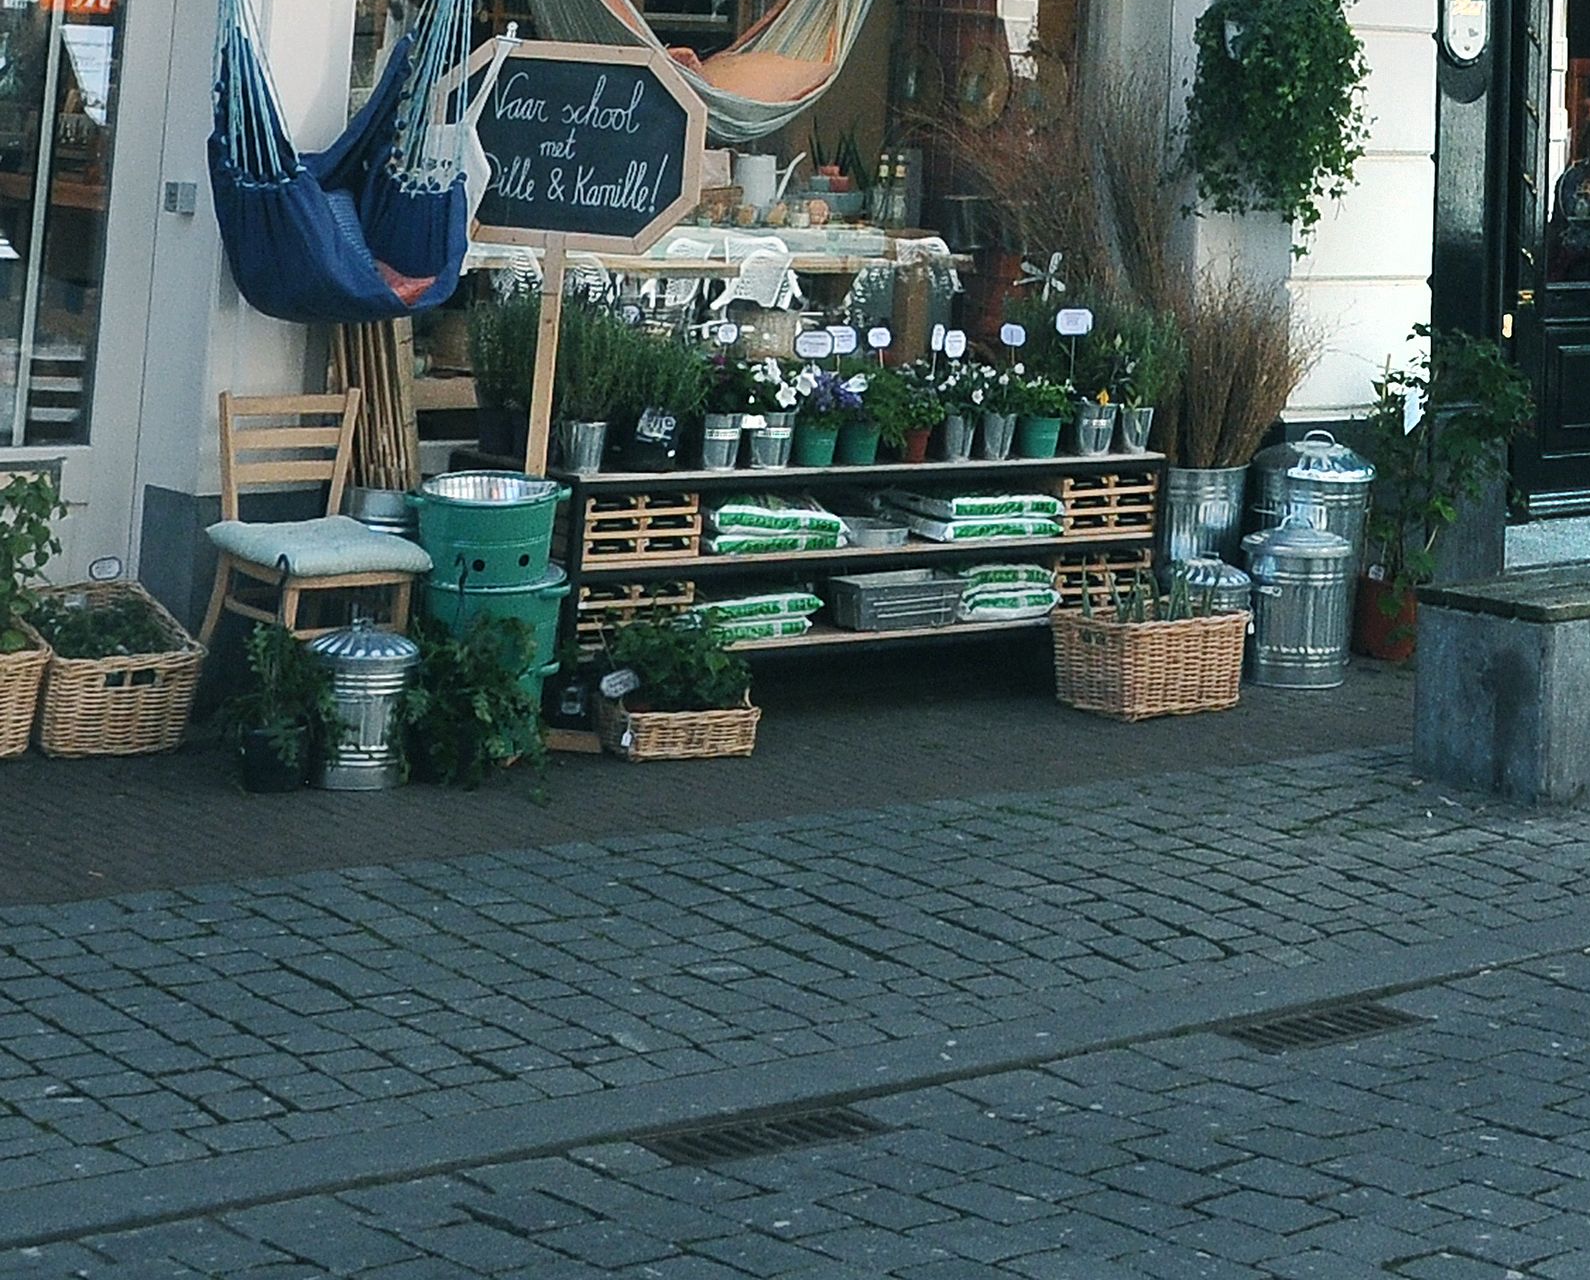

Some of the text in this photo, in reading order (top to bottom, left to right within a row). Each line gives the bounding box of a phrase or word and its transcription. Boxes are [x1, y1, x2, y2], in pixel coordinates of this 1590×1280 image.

[561, 74, 644, 134] school
[540, 128, 576, 160] met
[547, 167, 566, 202] &
[571, 154, 668, 214] Kamille!
